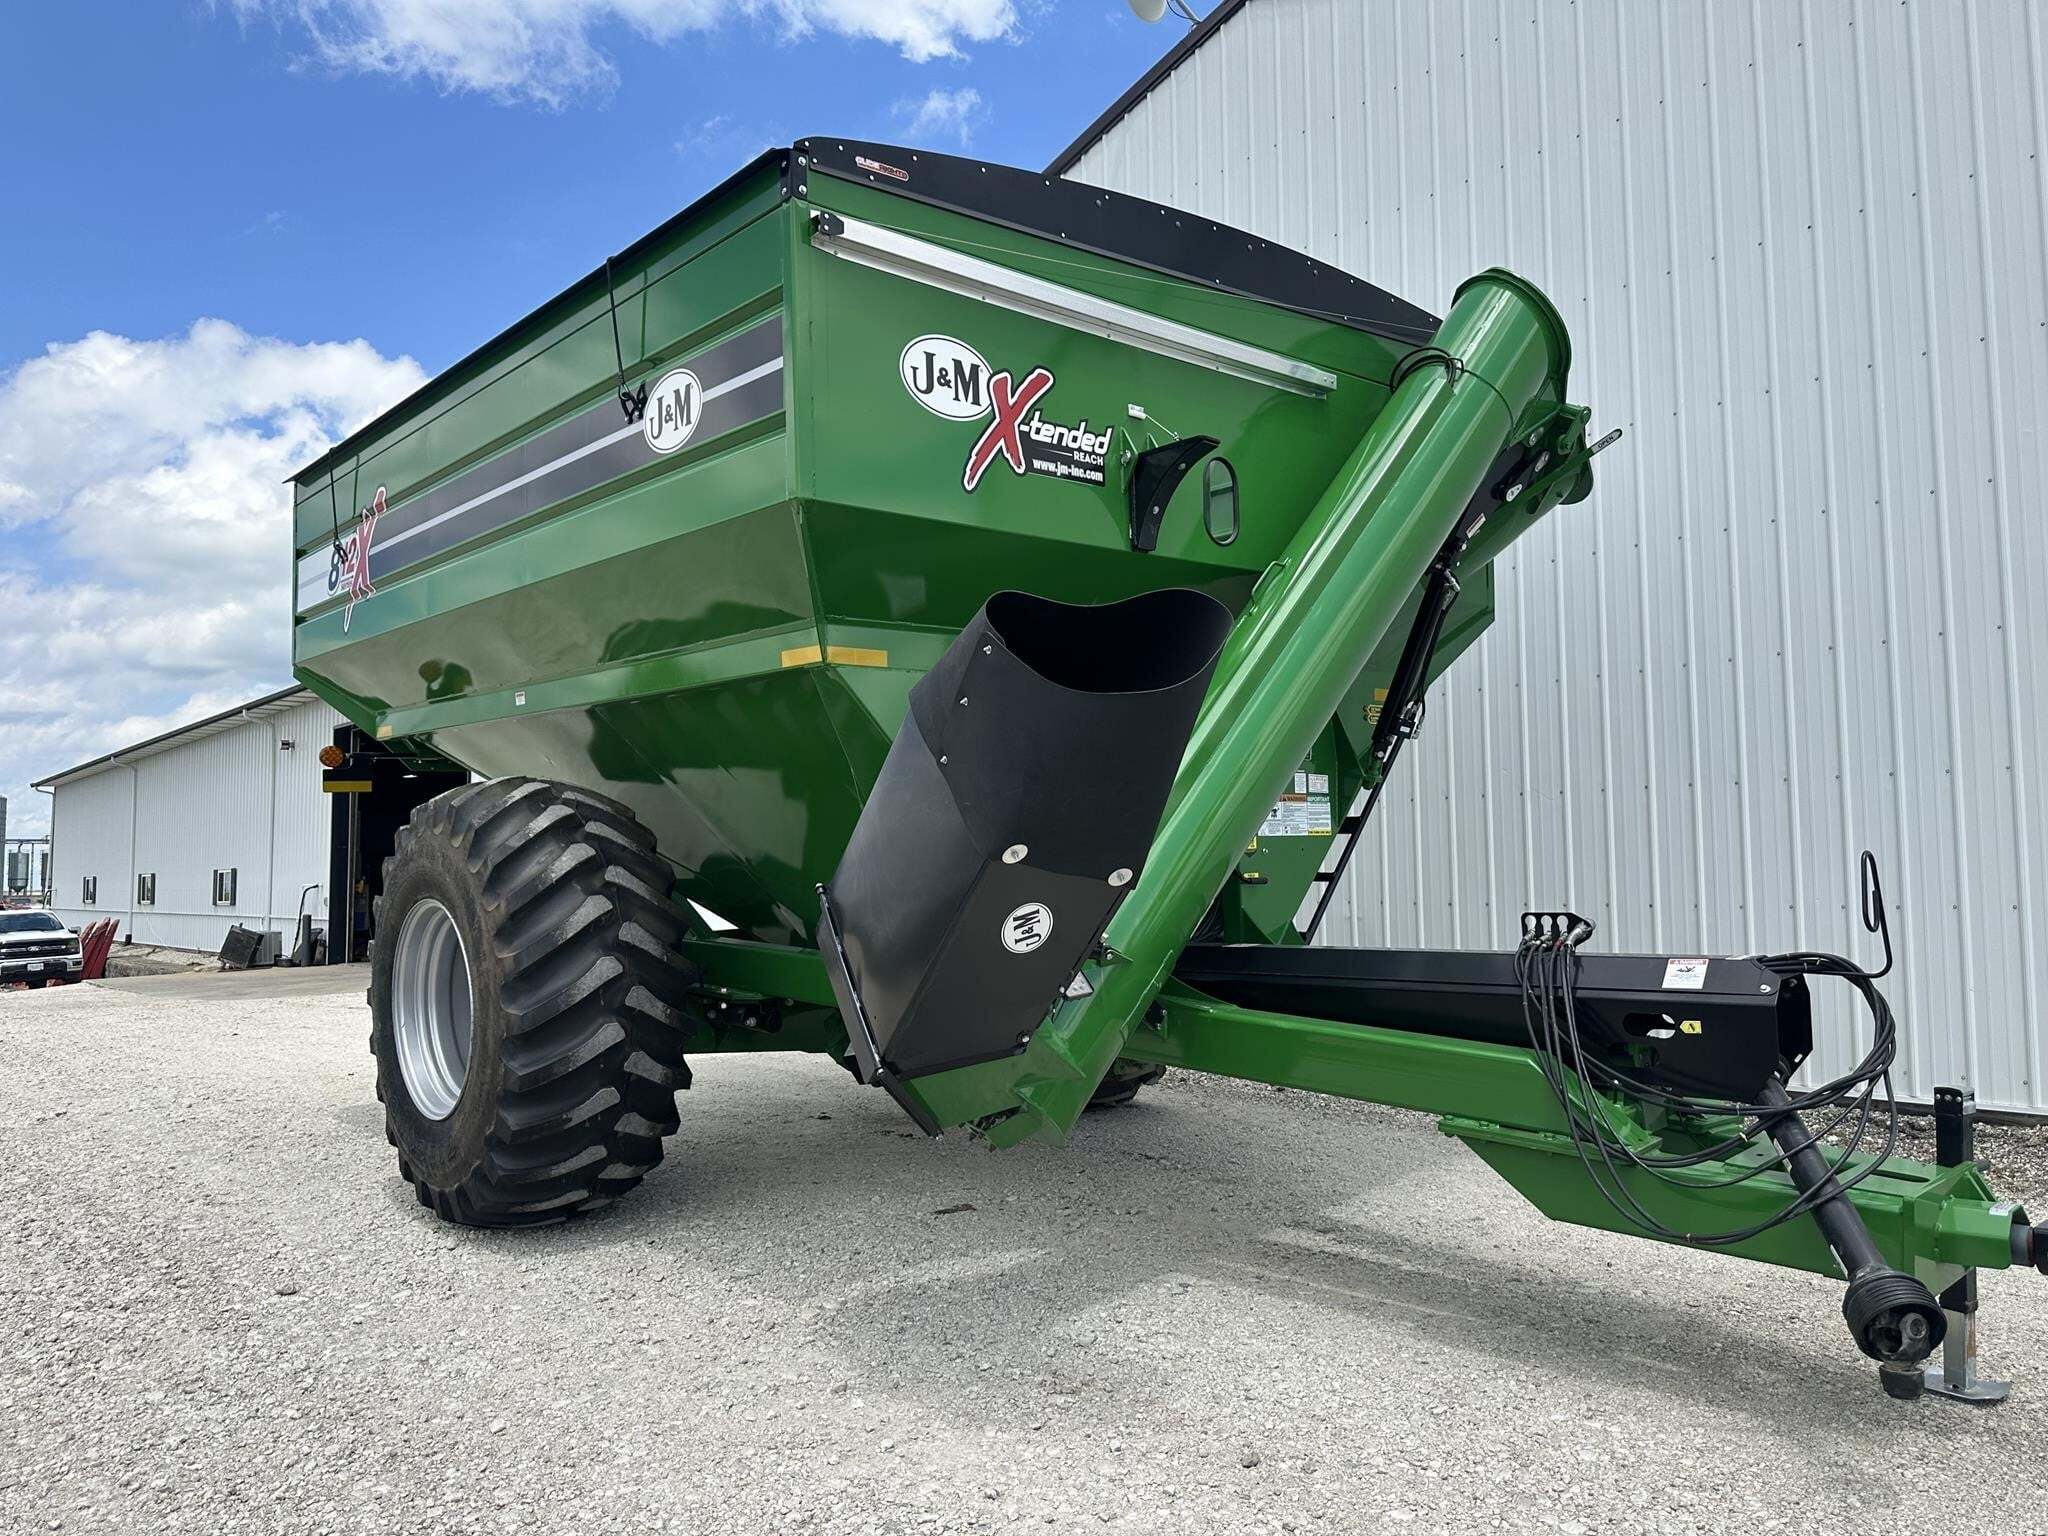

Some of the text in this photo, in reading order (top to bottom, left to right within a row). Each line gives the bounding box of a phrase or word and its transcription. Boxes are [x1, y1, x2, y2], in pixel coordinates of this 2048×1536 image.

[910, 350, 982, 407] J&M
[649, 382, 693, 441] J&M
[1031, 458, 1104, 483] www.jm-inc.com
[1073, 451, 1104, 467] REACH
[1012, 908, 1042, 948] J&M
